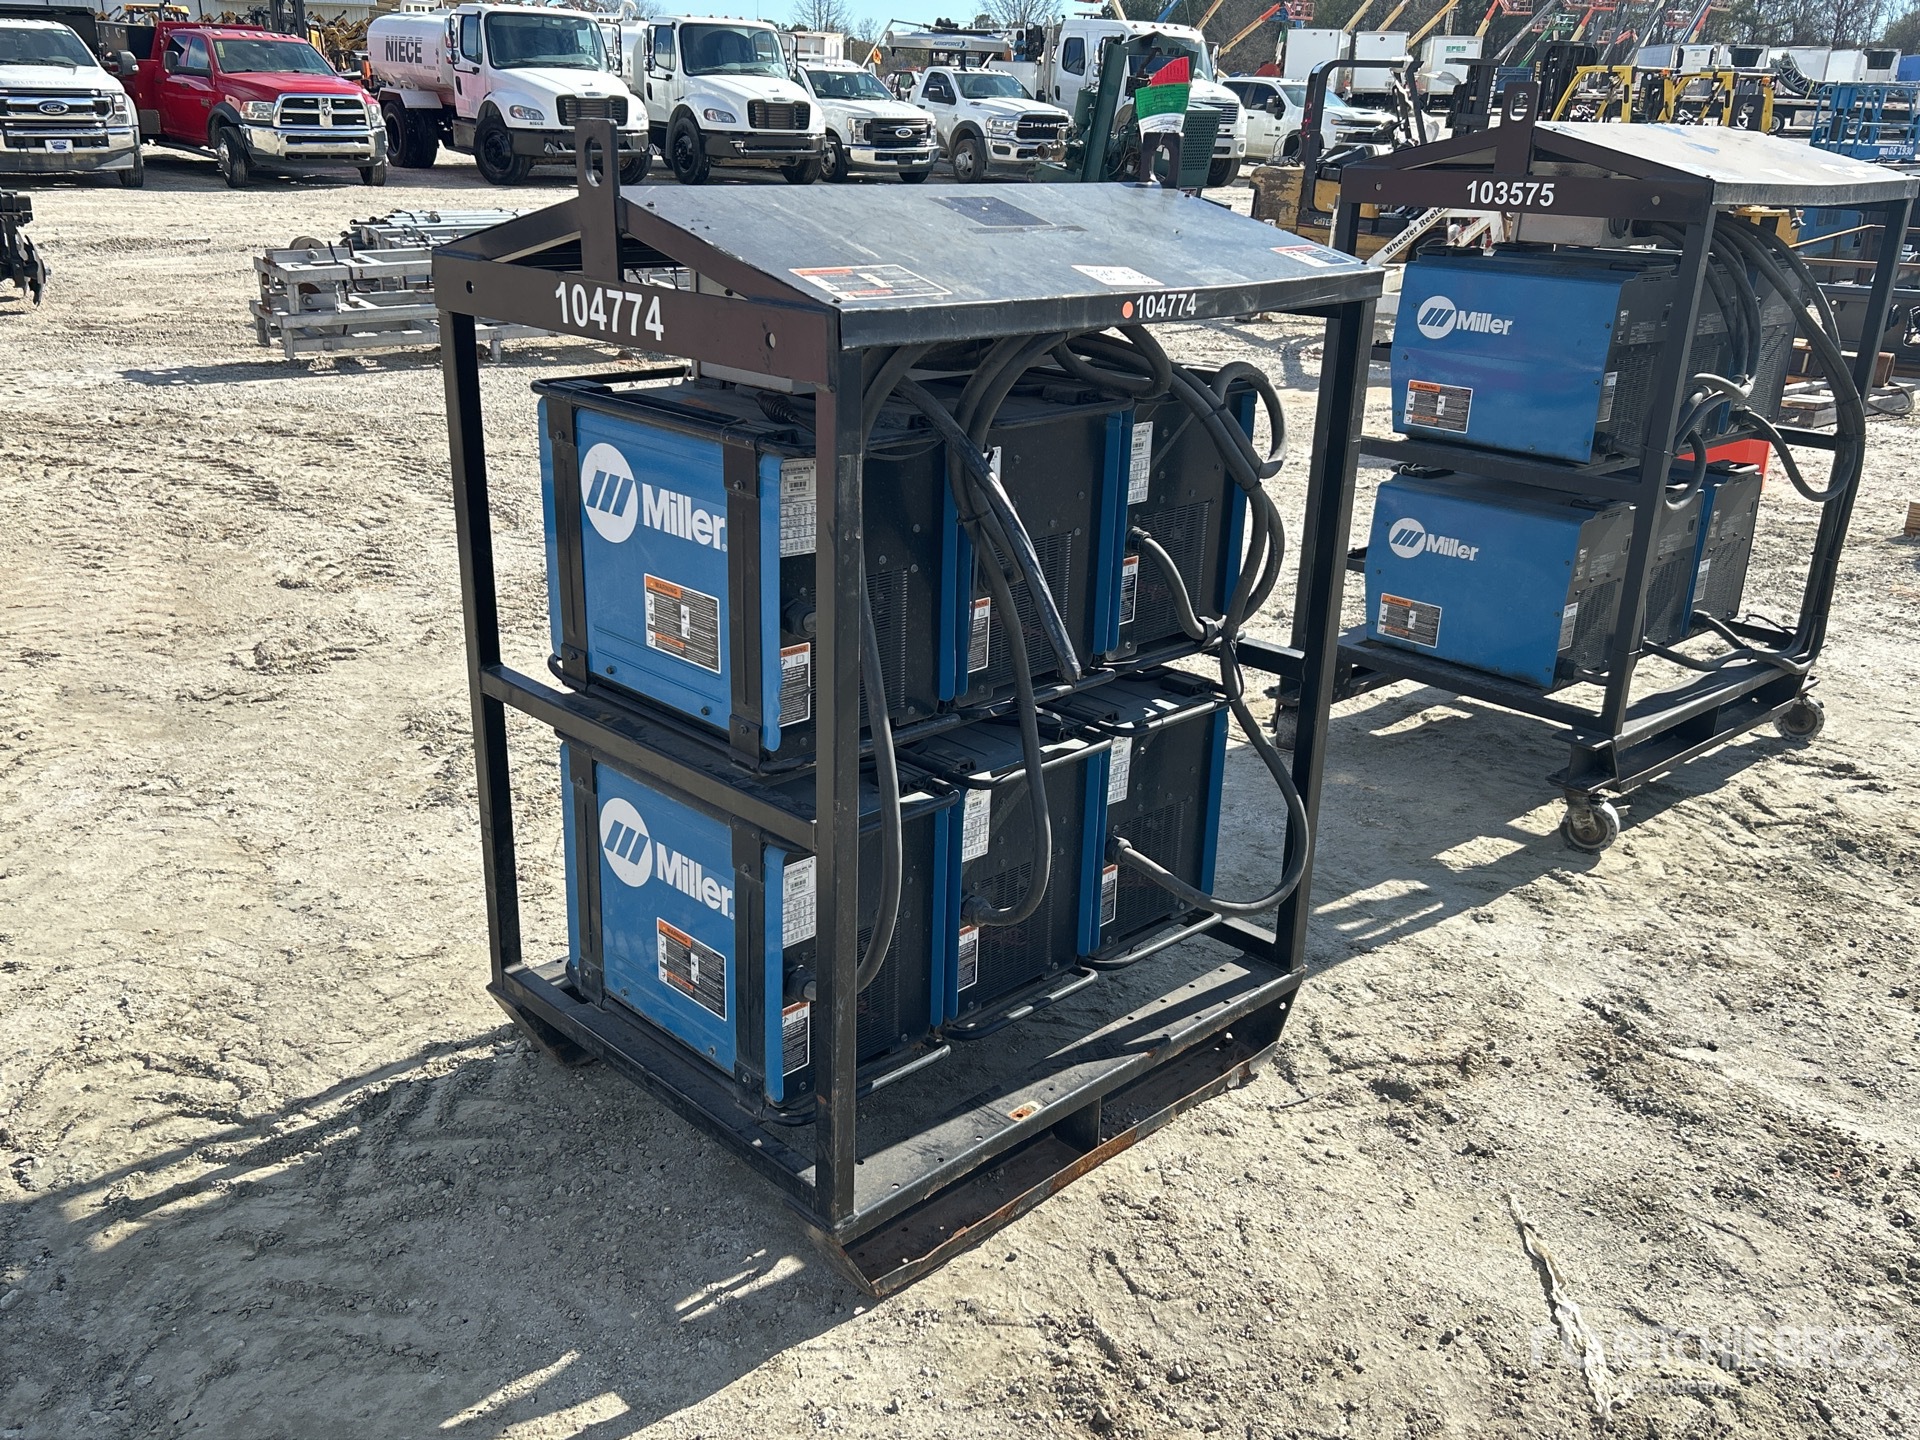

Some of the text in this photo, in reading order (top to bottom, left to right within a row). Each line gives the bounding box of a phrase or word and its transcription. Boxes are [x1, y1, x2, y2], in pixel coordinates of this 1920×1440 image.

[385, 35, 423, 64] NIECE
[1888, 146, 1898, 156] GS
[1466, 180, 1555, 207] 103575
[1383, 226, 1418, 255] Wheeler
[554, 280, 665, 342] 104774
[1136, 292, 1197, 319] 104774
[1456, 310, 1514, 336] Miller
[641, 482, 727, 552] Miller
[1425, 533, 1480, 562] Miller
[655, 581, 678, 595] WARNING
[656, 841, 734, 919] Miller
